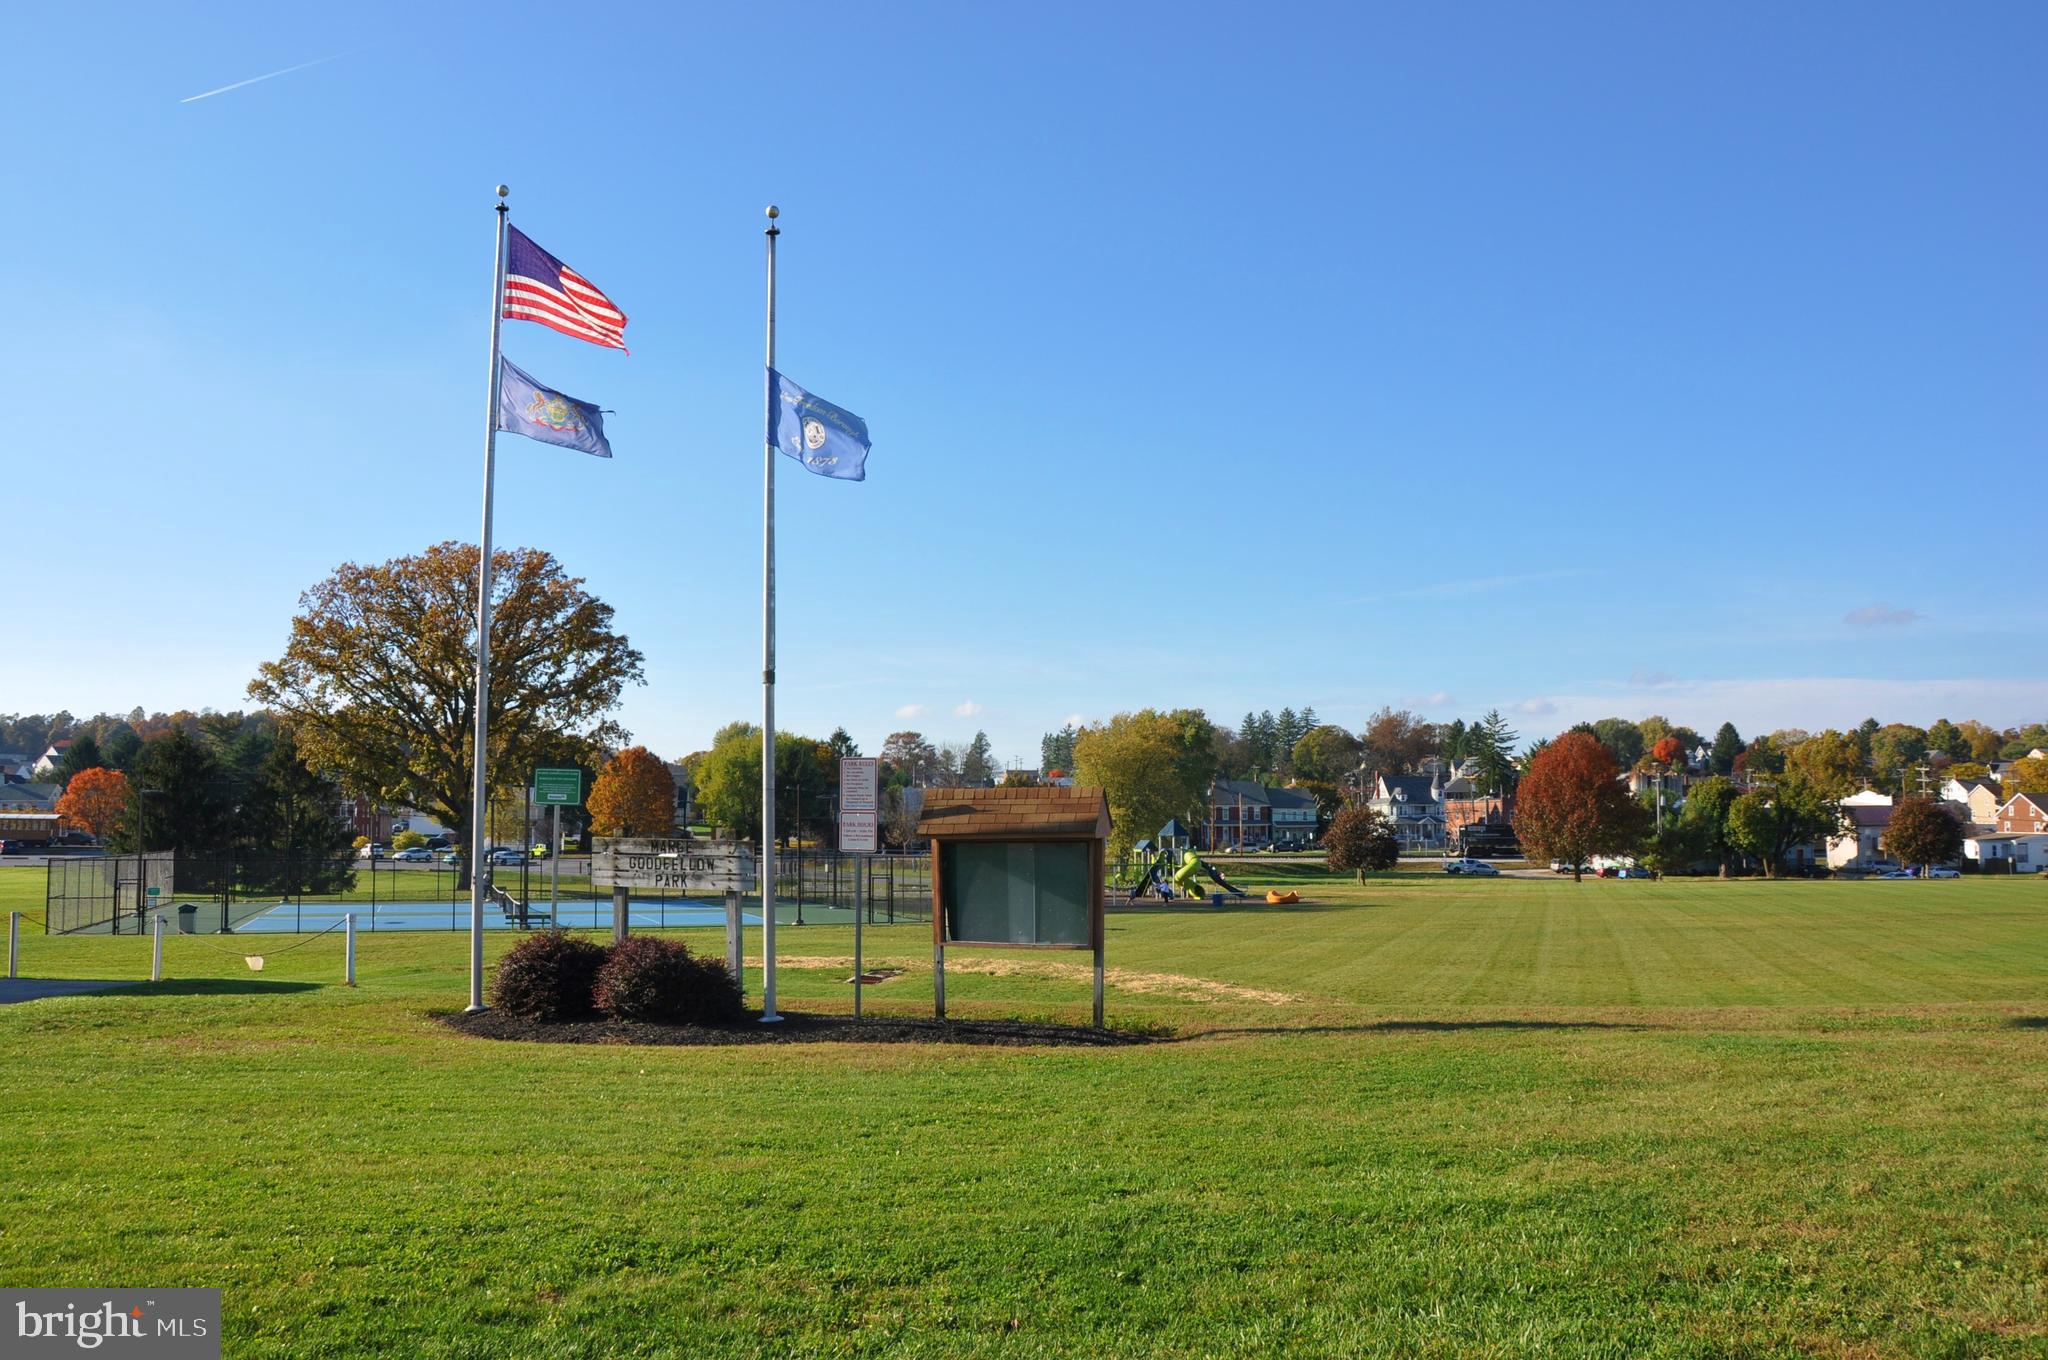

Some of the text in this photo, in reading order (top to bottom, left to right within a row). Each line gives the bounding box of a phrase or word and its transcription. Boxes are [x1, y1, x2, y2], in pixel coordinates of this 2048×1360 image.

[650, 840, 693, 853] MARGE
[629, 856, 715, 872] GOODFELLOW
[655, 874, 688, 888] PARK
